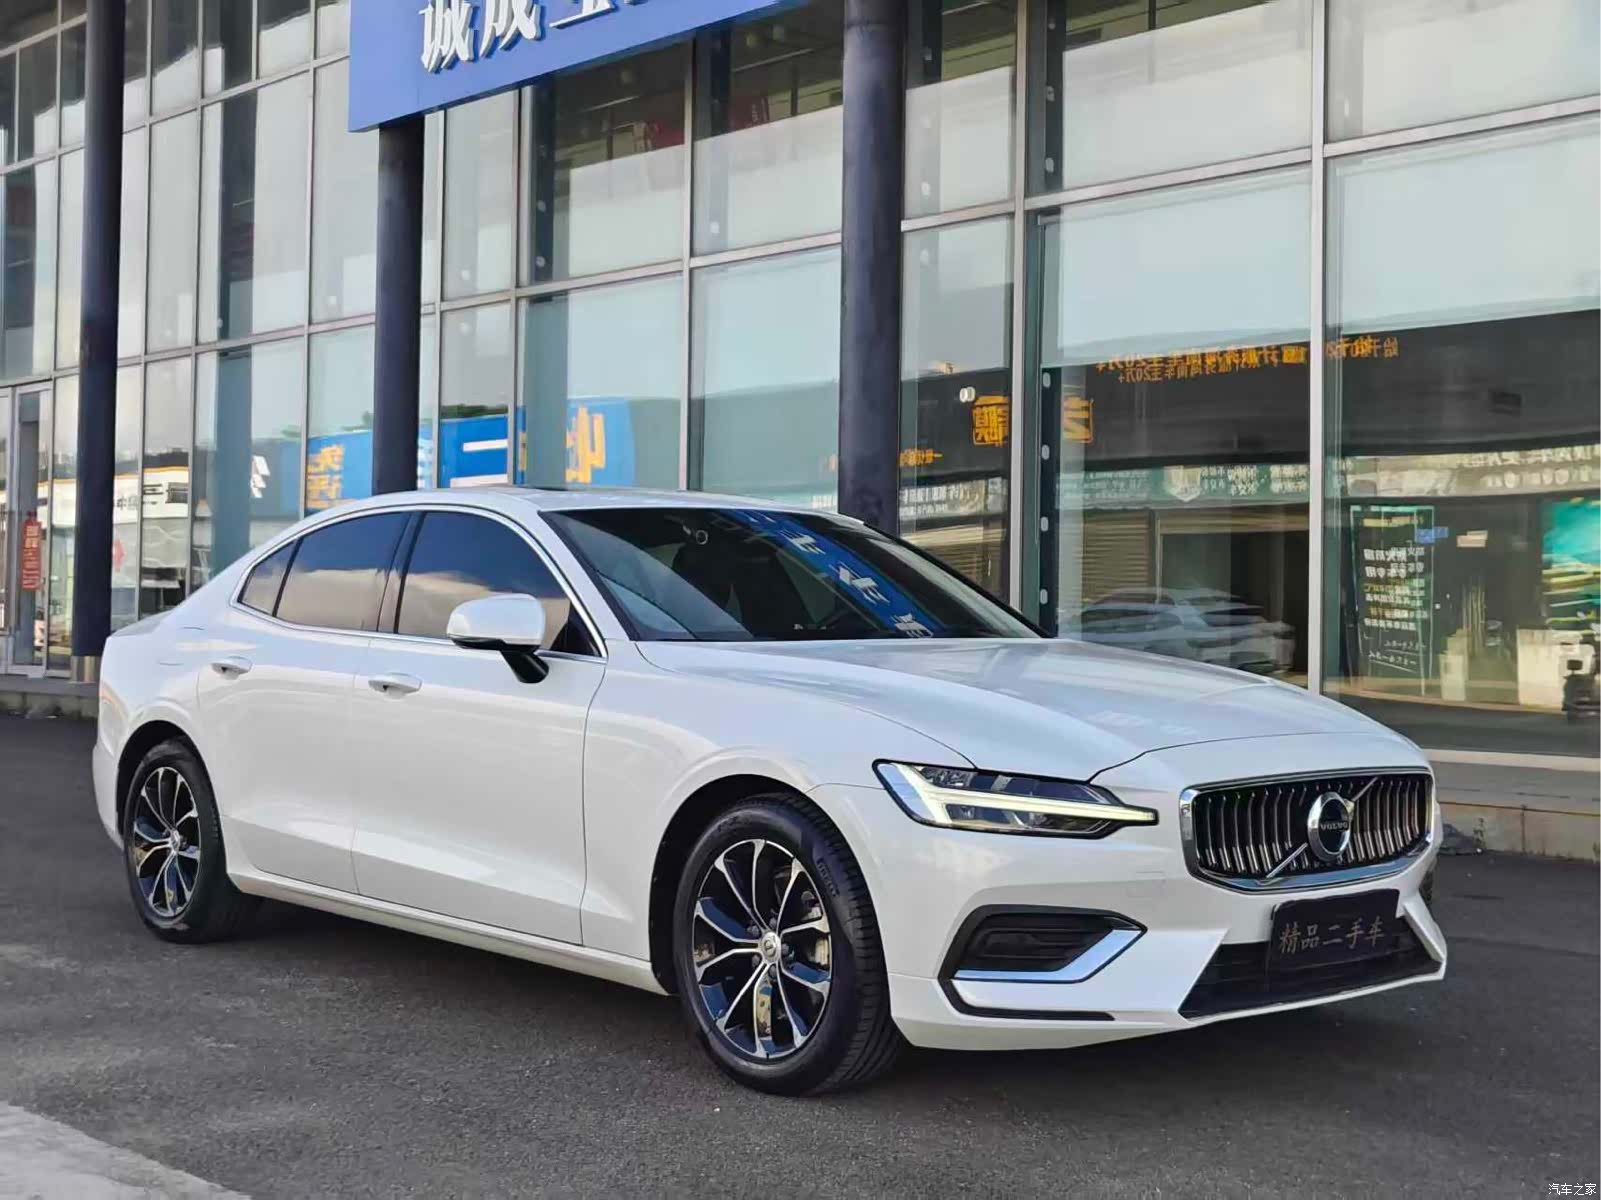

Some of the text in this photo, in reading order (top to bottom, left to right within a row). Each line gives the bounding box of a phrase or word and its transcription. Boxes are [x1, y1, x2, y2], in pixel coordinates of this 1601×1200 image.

[1320, 821, 1348, 831] VOLVO
[1279, 915, 1386, 955] 精品二手车
